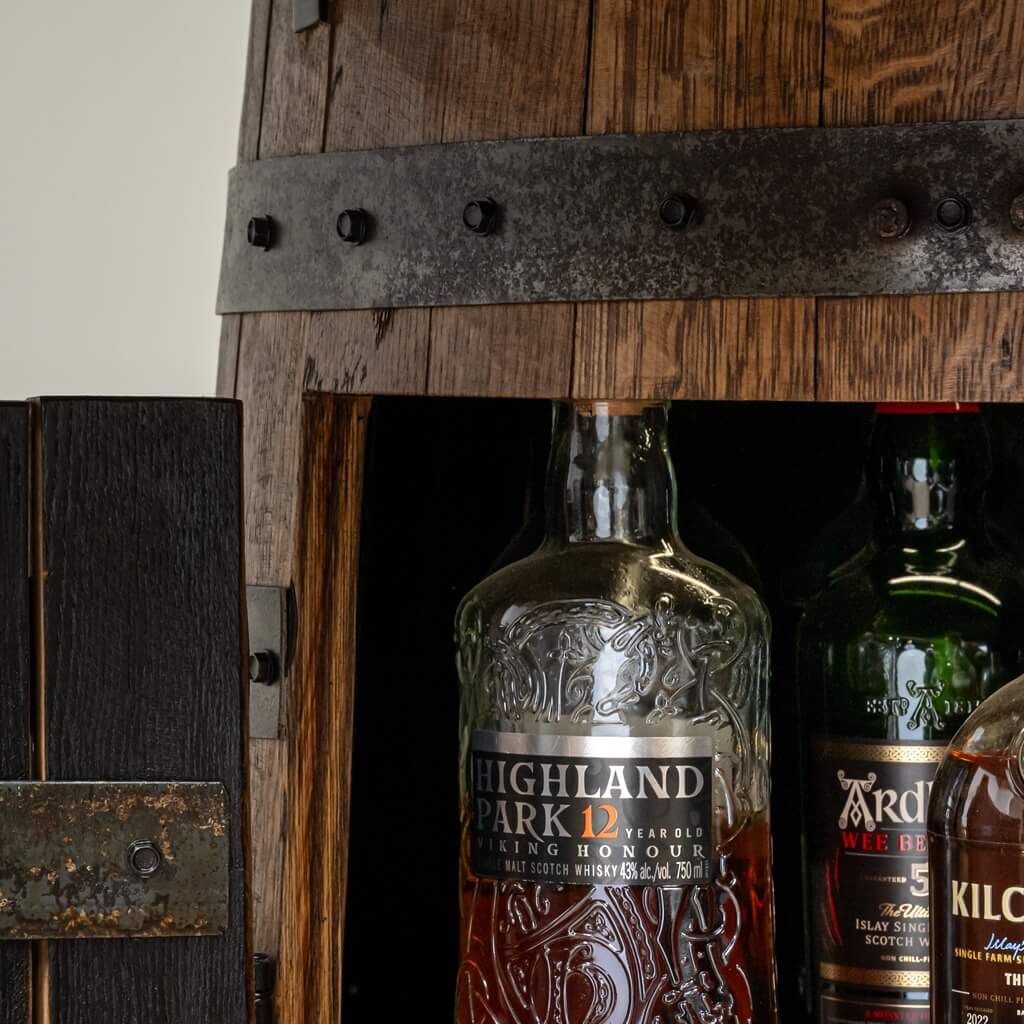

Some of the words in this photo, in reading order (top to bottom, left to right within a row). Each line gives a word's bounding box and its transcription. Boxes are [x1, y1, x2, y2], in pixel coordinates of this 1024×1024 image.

[476, 758, 704, 799] HIGHLAND
[837, 769, 935, 832] Ard
[477, 800, 572, 843] PARK
[580, 803, 619, 839] 12
[626, 828, 667, 840] YEAR
[675, 827, 704, 838] OLD
[477, 836, 559, 857] VIKING
[577, 844, 705, 859] HONOUR
[841, 831, 888, 851] WEE
[505, 860, 527, 873] MALT
[531, 862, 569, 876] SCOTCH
[575, 863, 618, 878] WHISKY
[620, 861, 638, 880] 43%
[676, 861, 692, 880] 750
[694, 861, 703, 879] ml
[894, 920, 929, 933] SING
[865, 934, 913, 947] SCOTCH
[954, 947, 982, 961] SINGLE
[985, 952, 1012, 963] FARM
